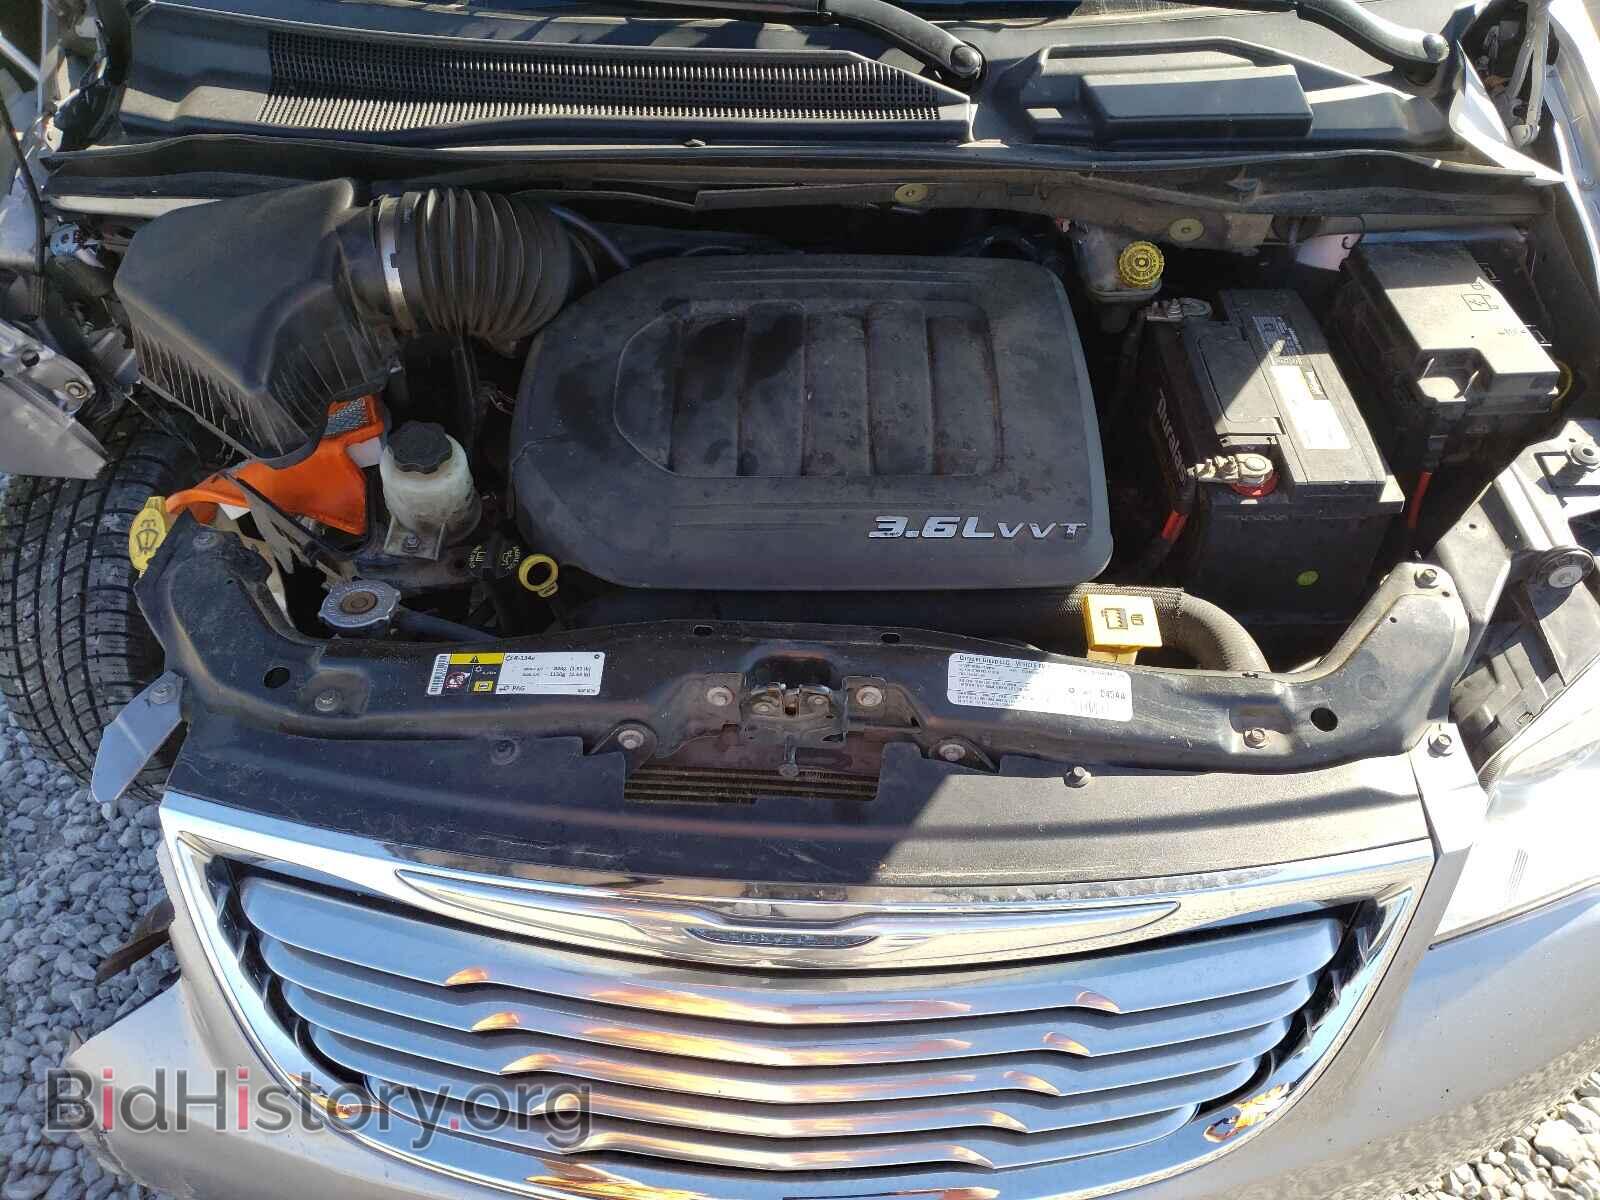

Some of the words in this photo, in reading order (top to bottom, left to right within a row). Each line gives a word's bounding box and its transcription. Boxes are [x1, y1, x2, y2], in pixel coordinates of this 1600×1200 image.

[1157, 387, 1187, 483] Duralas
[868, 515, 995, 539] 3.6L
[997, 521, 1088, 540] VVT
